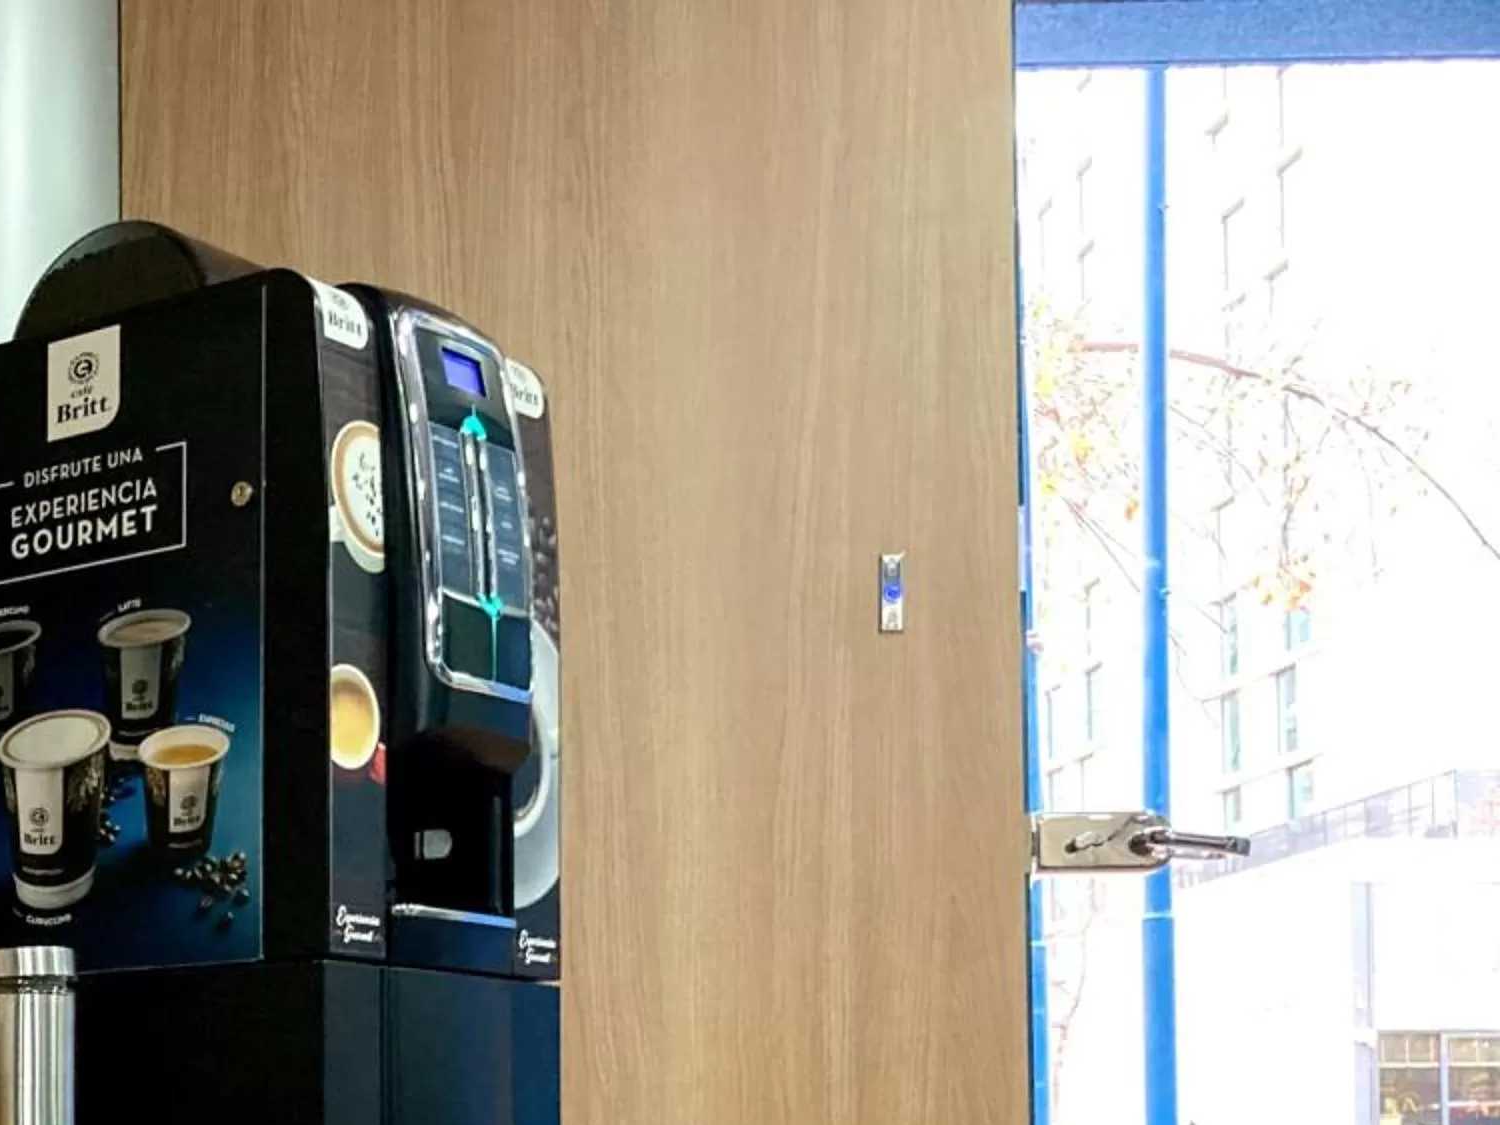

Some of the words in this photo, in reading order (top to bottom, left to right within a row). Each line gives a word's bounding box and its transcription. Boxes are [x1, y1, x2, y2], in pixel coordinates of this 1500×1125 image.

[328, 309, 363, 333] Britt
[57, 396, 108, 424] Britt
[23, 455, 102, 488] DISFRUTE
[107, 447, 144, 469] UNA
[10, 477, 158, 528] EXPERIENCIA
[11, 504, 158, 560] GOURMET
[23, 831, 57, 847] Britt
